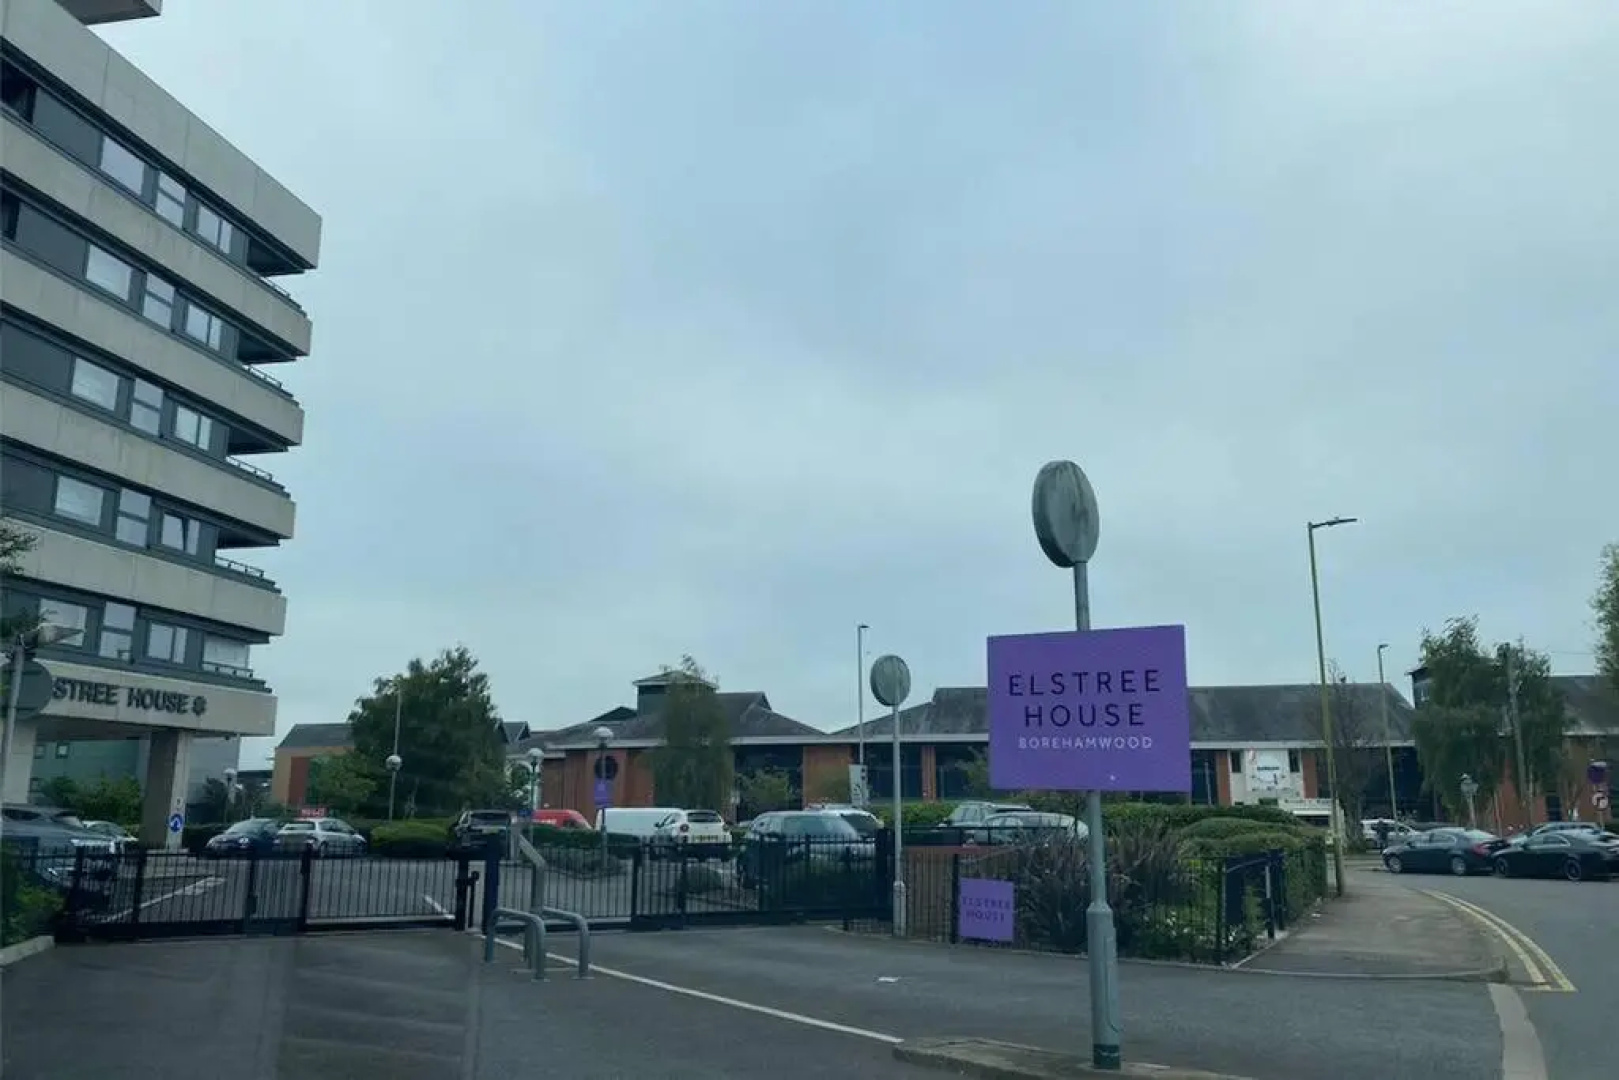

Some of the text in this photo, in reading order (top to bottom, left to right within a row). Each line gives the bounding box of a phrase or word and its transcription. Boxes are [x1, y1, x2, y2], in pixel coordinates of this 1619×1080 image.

[52, 677, 188, 714] STREE HOUSE
[1008, 669, 1161, 697] ELSTREE
[1024, 703, 1144, 728] HOUSE
[1018, 736, 1153, 749] BOREHAMWOOD
